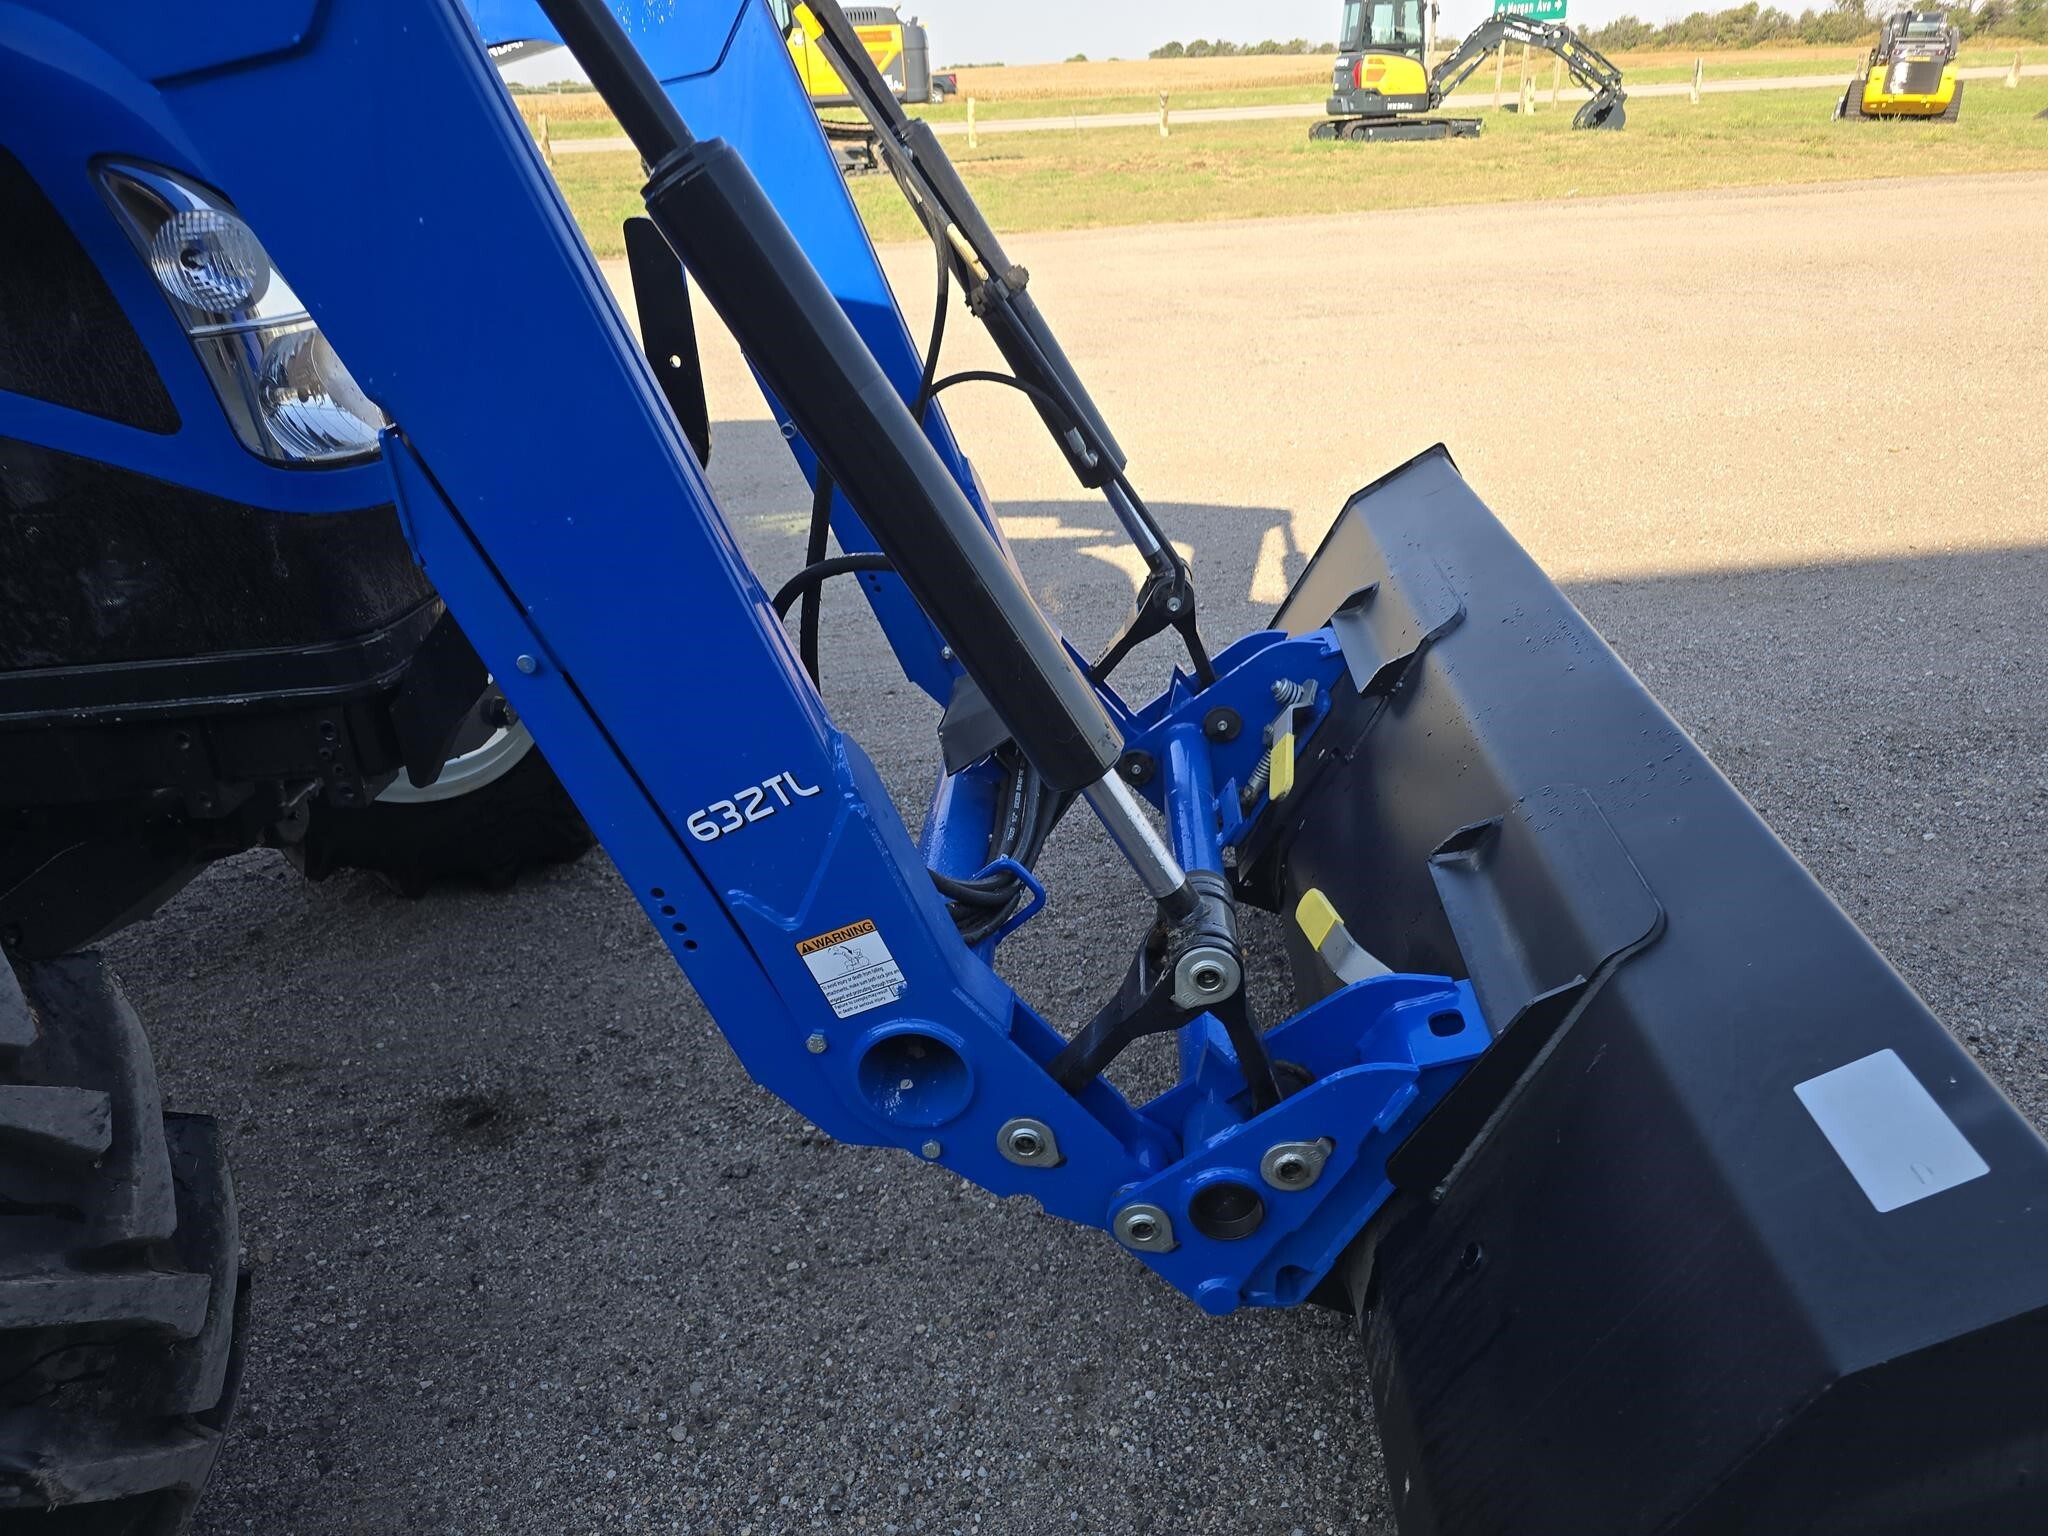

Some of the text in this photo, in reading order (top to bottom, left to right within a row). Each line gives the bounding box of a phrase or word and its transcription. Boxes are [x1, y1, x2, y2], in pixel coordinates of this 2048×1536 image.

[1507, 0, 1551, 15] Morgan Ave
[1503, 26, 1532, 43] HYUNDAI
[686, 770, 820, 842] 632TL
[812, 922, 874, 949] WARNING
